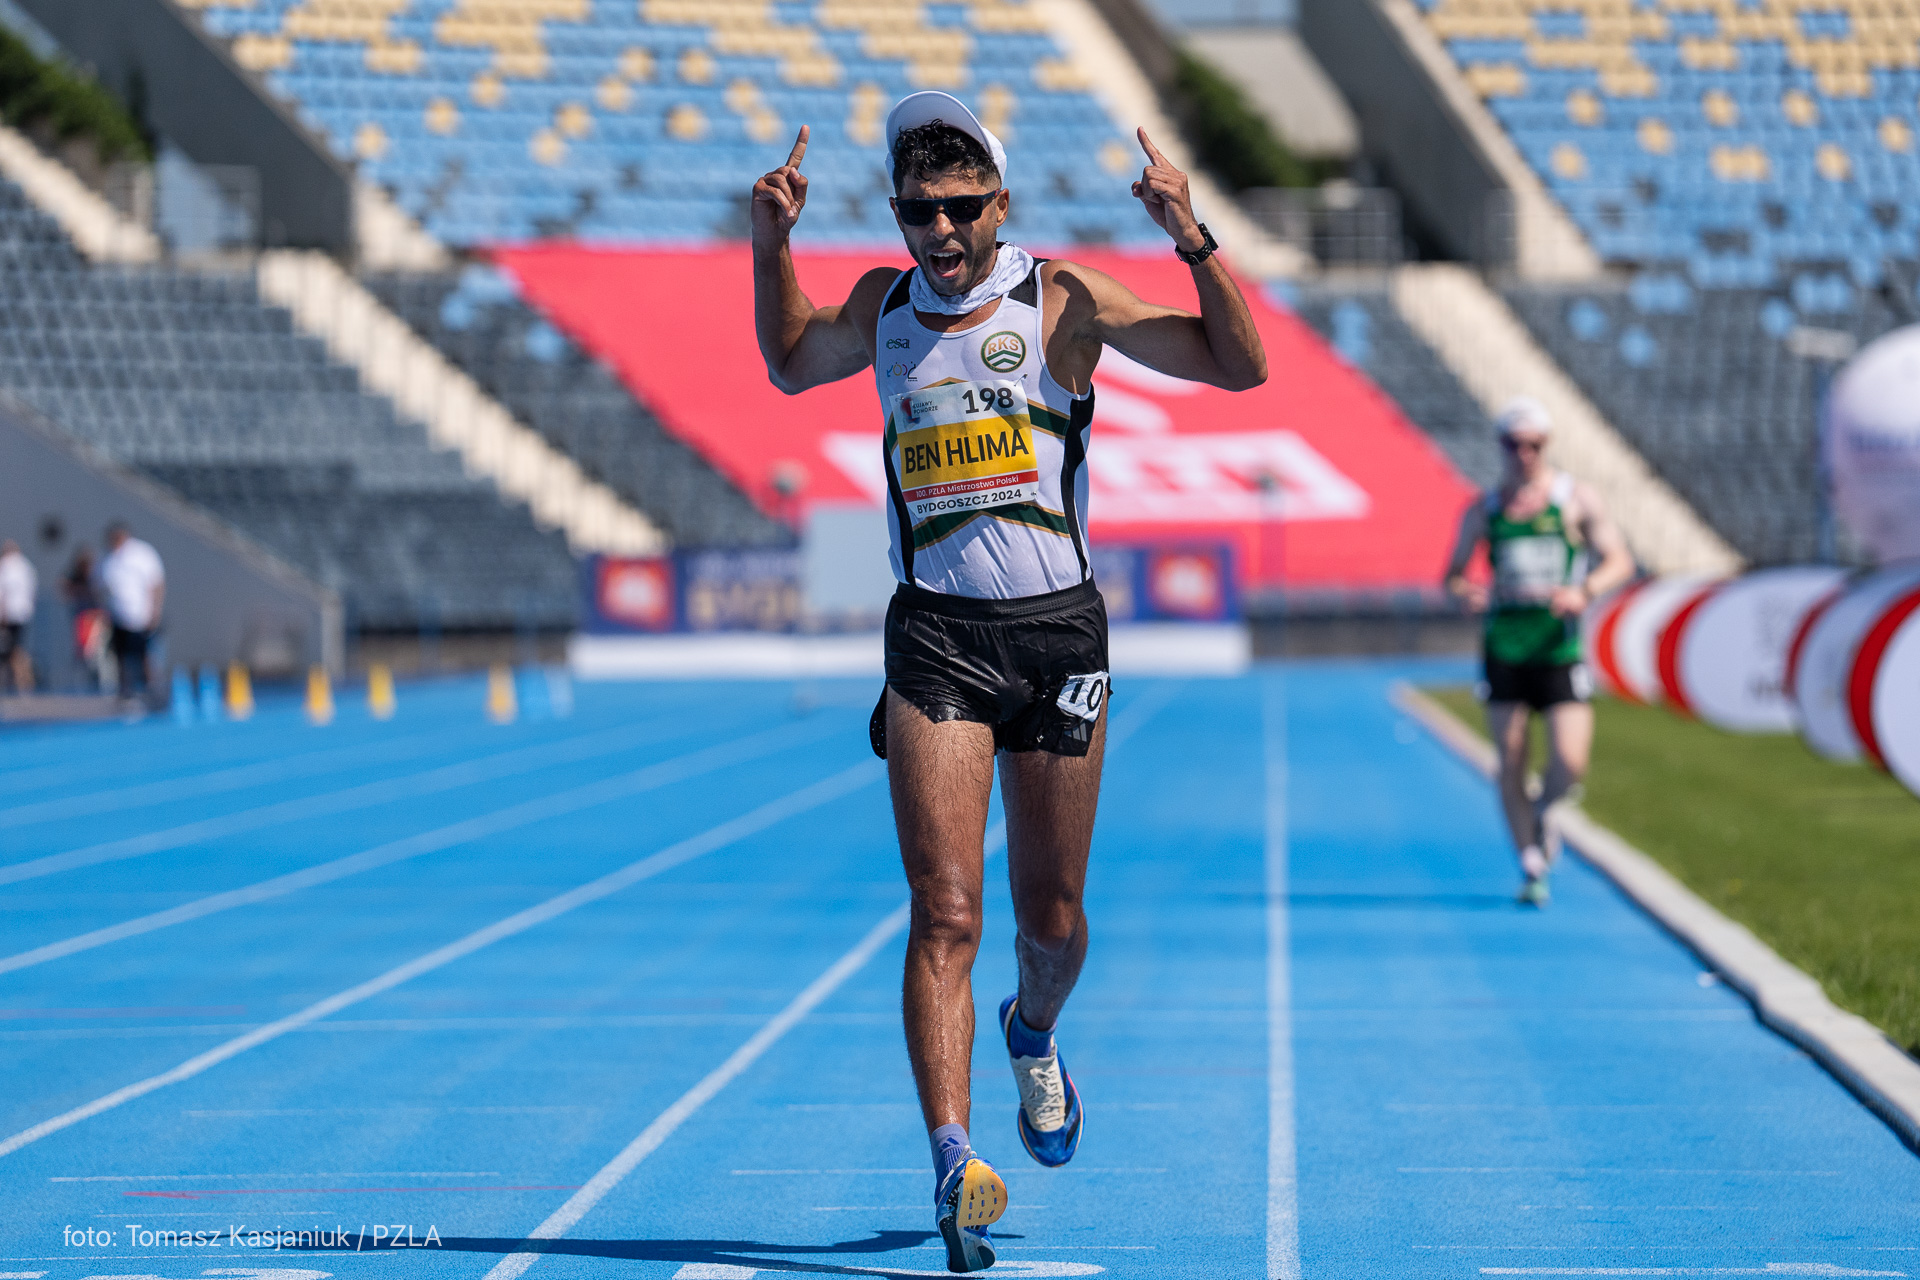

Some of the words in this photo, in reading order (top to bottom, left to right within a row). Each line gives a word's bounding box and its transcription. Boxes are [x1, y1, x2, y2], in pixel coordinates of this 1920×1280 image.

[886, 338, 911, 349] esa
[988, 336, 1019, 355] RKS
[914, 406, 939, 414] POMORZE
[962, 387, 1015, 414] 198
[904, 441, 942, 474] BEN
[946, 429, 1029, 467] HLIMA
[915, 489, 927, 498] 100.
[928, 487, 946, 496] PZLA
[947, 479, 995, 494] Mistrzostwa
[996, 475, 1019, 485] Polski
[916, 495, 990, 514] BYDGOSZCZ
[991, 489, 1022, 503] 2024
